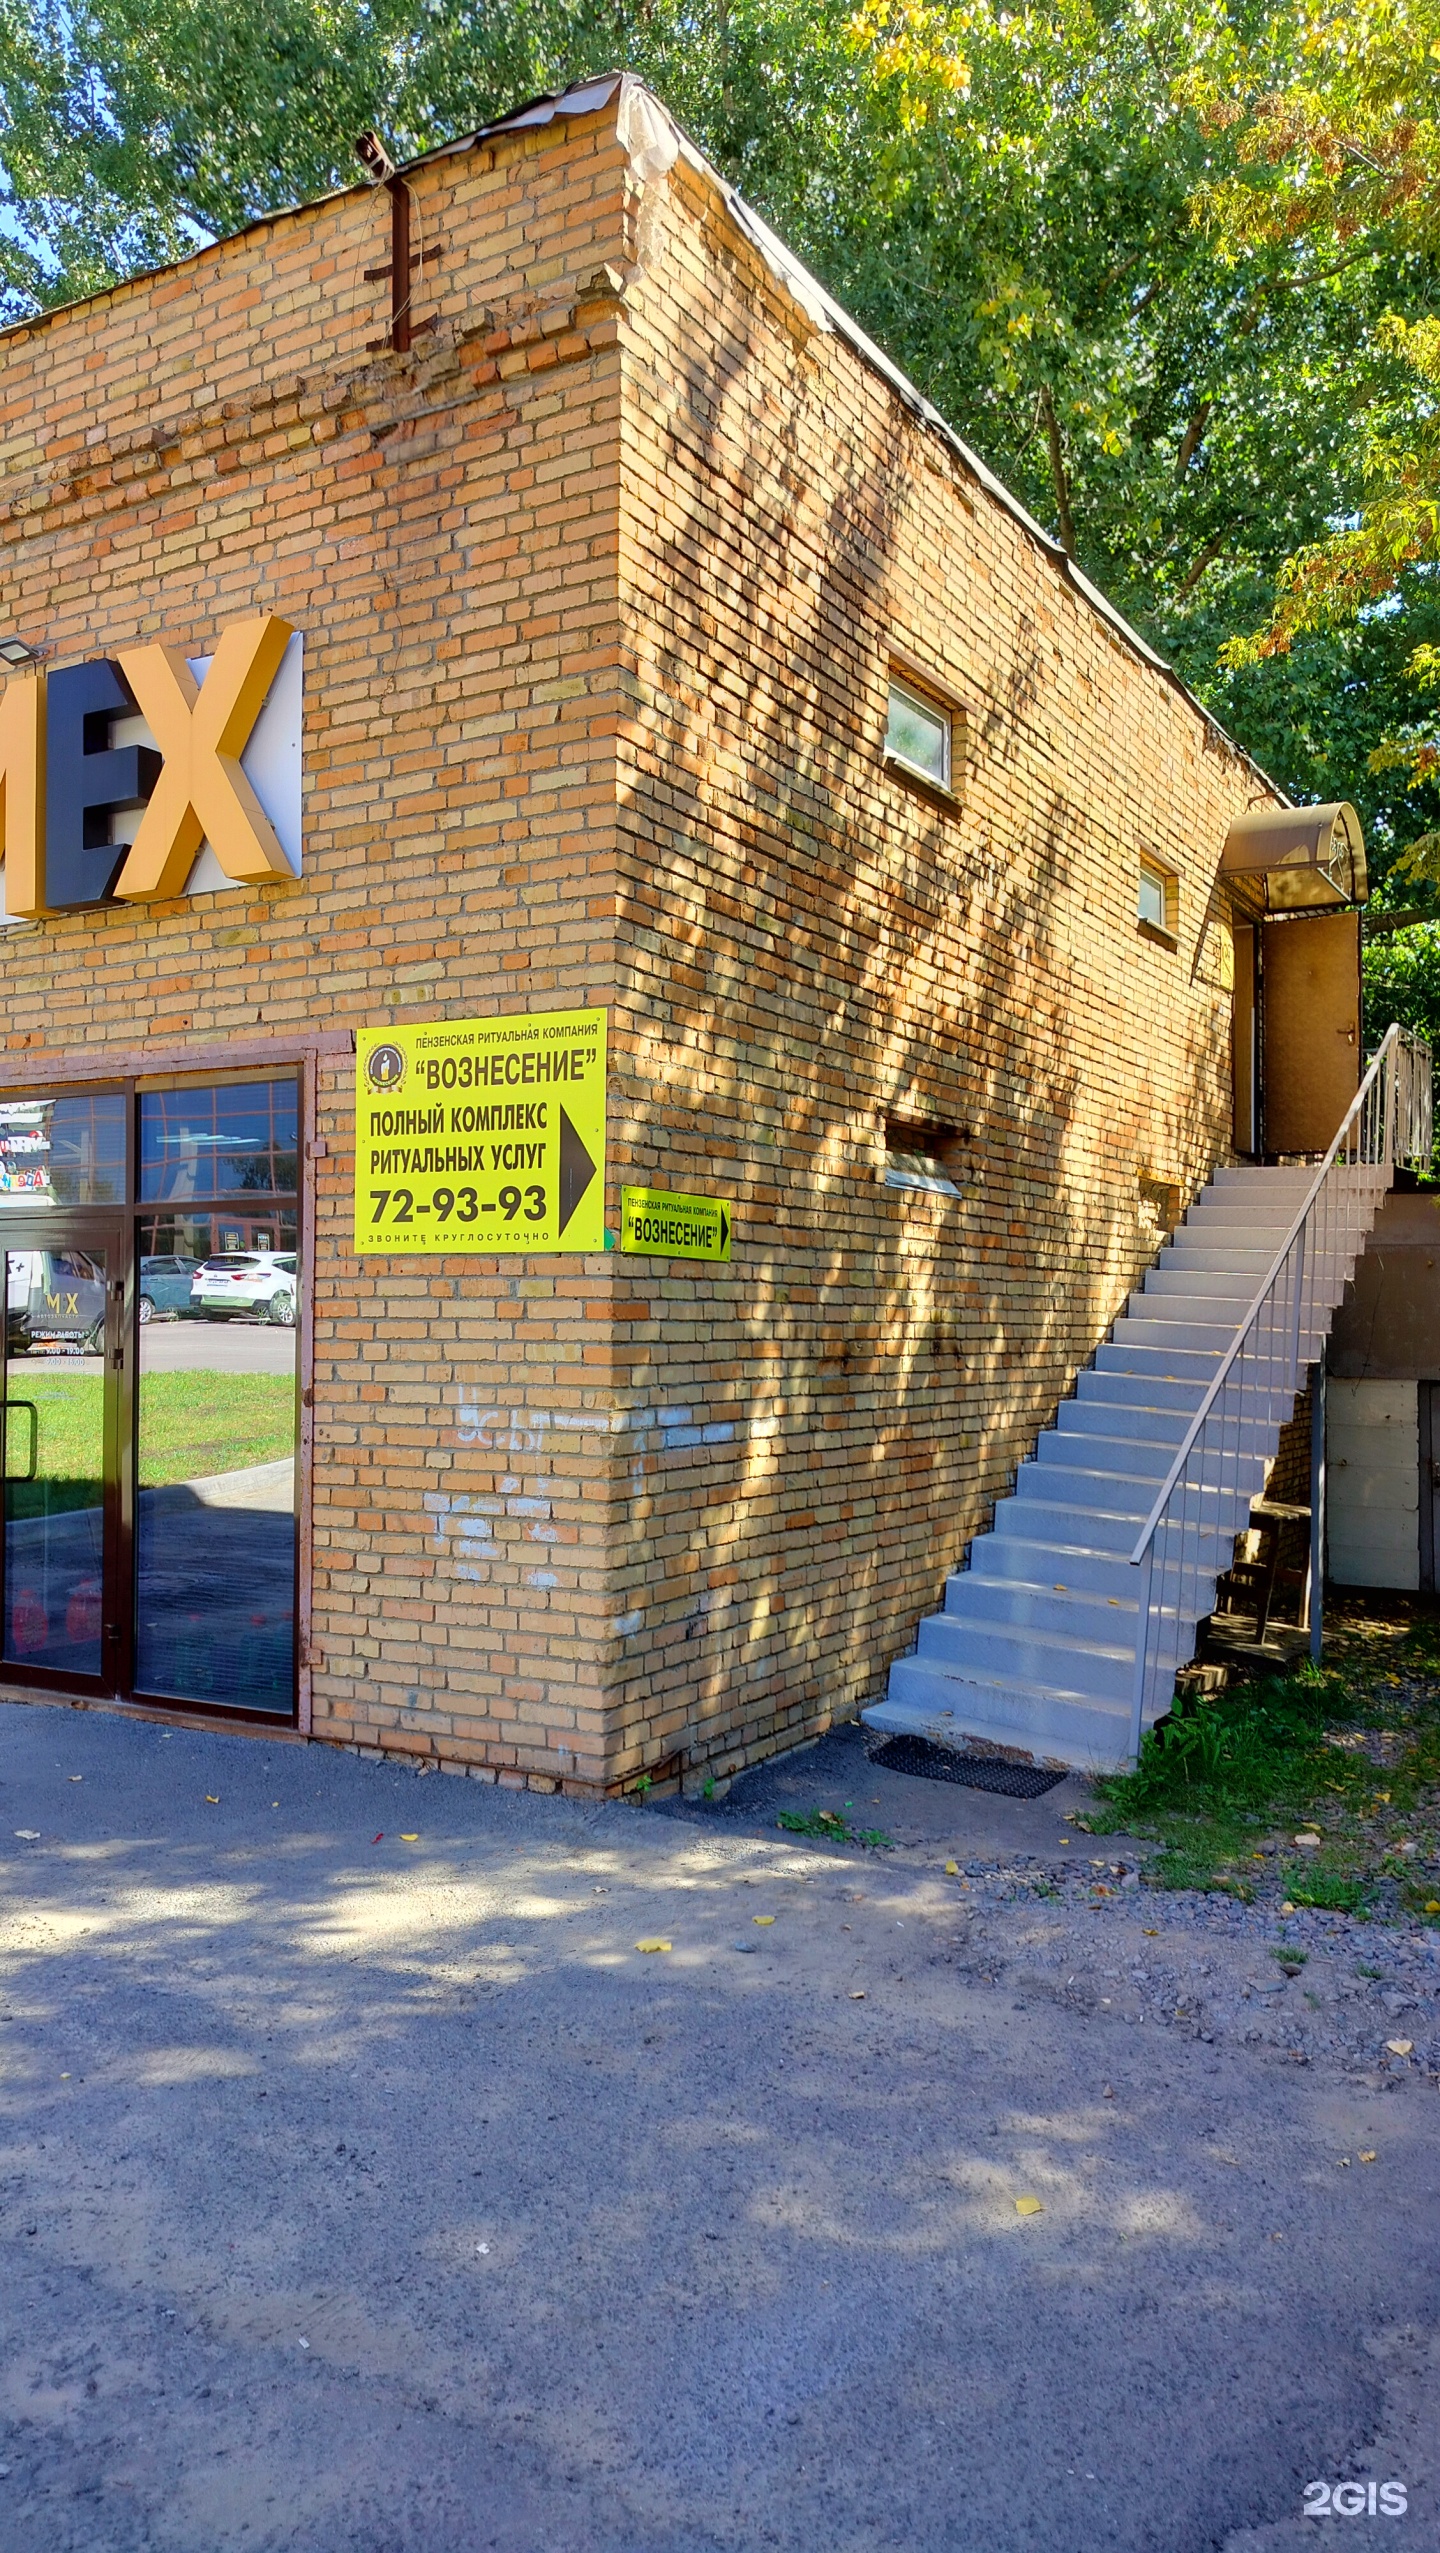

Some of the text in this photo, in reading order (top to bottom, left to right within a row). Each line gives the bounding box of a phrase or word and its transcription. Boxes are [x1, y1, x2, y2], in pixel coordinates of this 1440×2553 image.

[415, 1024, 598, 1049] ПЕНЗЕНСКАЯ РИТУАЛЬНАЯ КОМПАНИЯ
[370, 1101, 548, 1137] ПОЛНЫЙ КОМПЛЕКС
[370, 1142, 547, 1175] РИТУАЛЬНЫХ УСЛУГ
[369, 1185, 547, 1223] 72-93-93
[627, 1198, 718, 1218] ПЕНЗЕНСКАЯ РИТУАЛЬНАЯ КОМПАНИЯ
[368, 1232, 549, 1243] ЗВОНИТЕ КРУГЛОСУТОЧНО
[31, 1330, 85, 1339] РЕЖИМ РАБОТЫ
